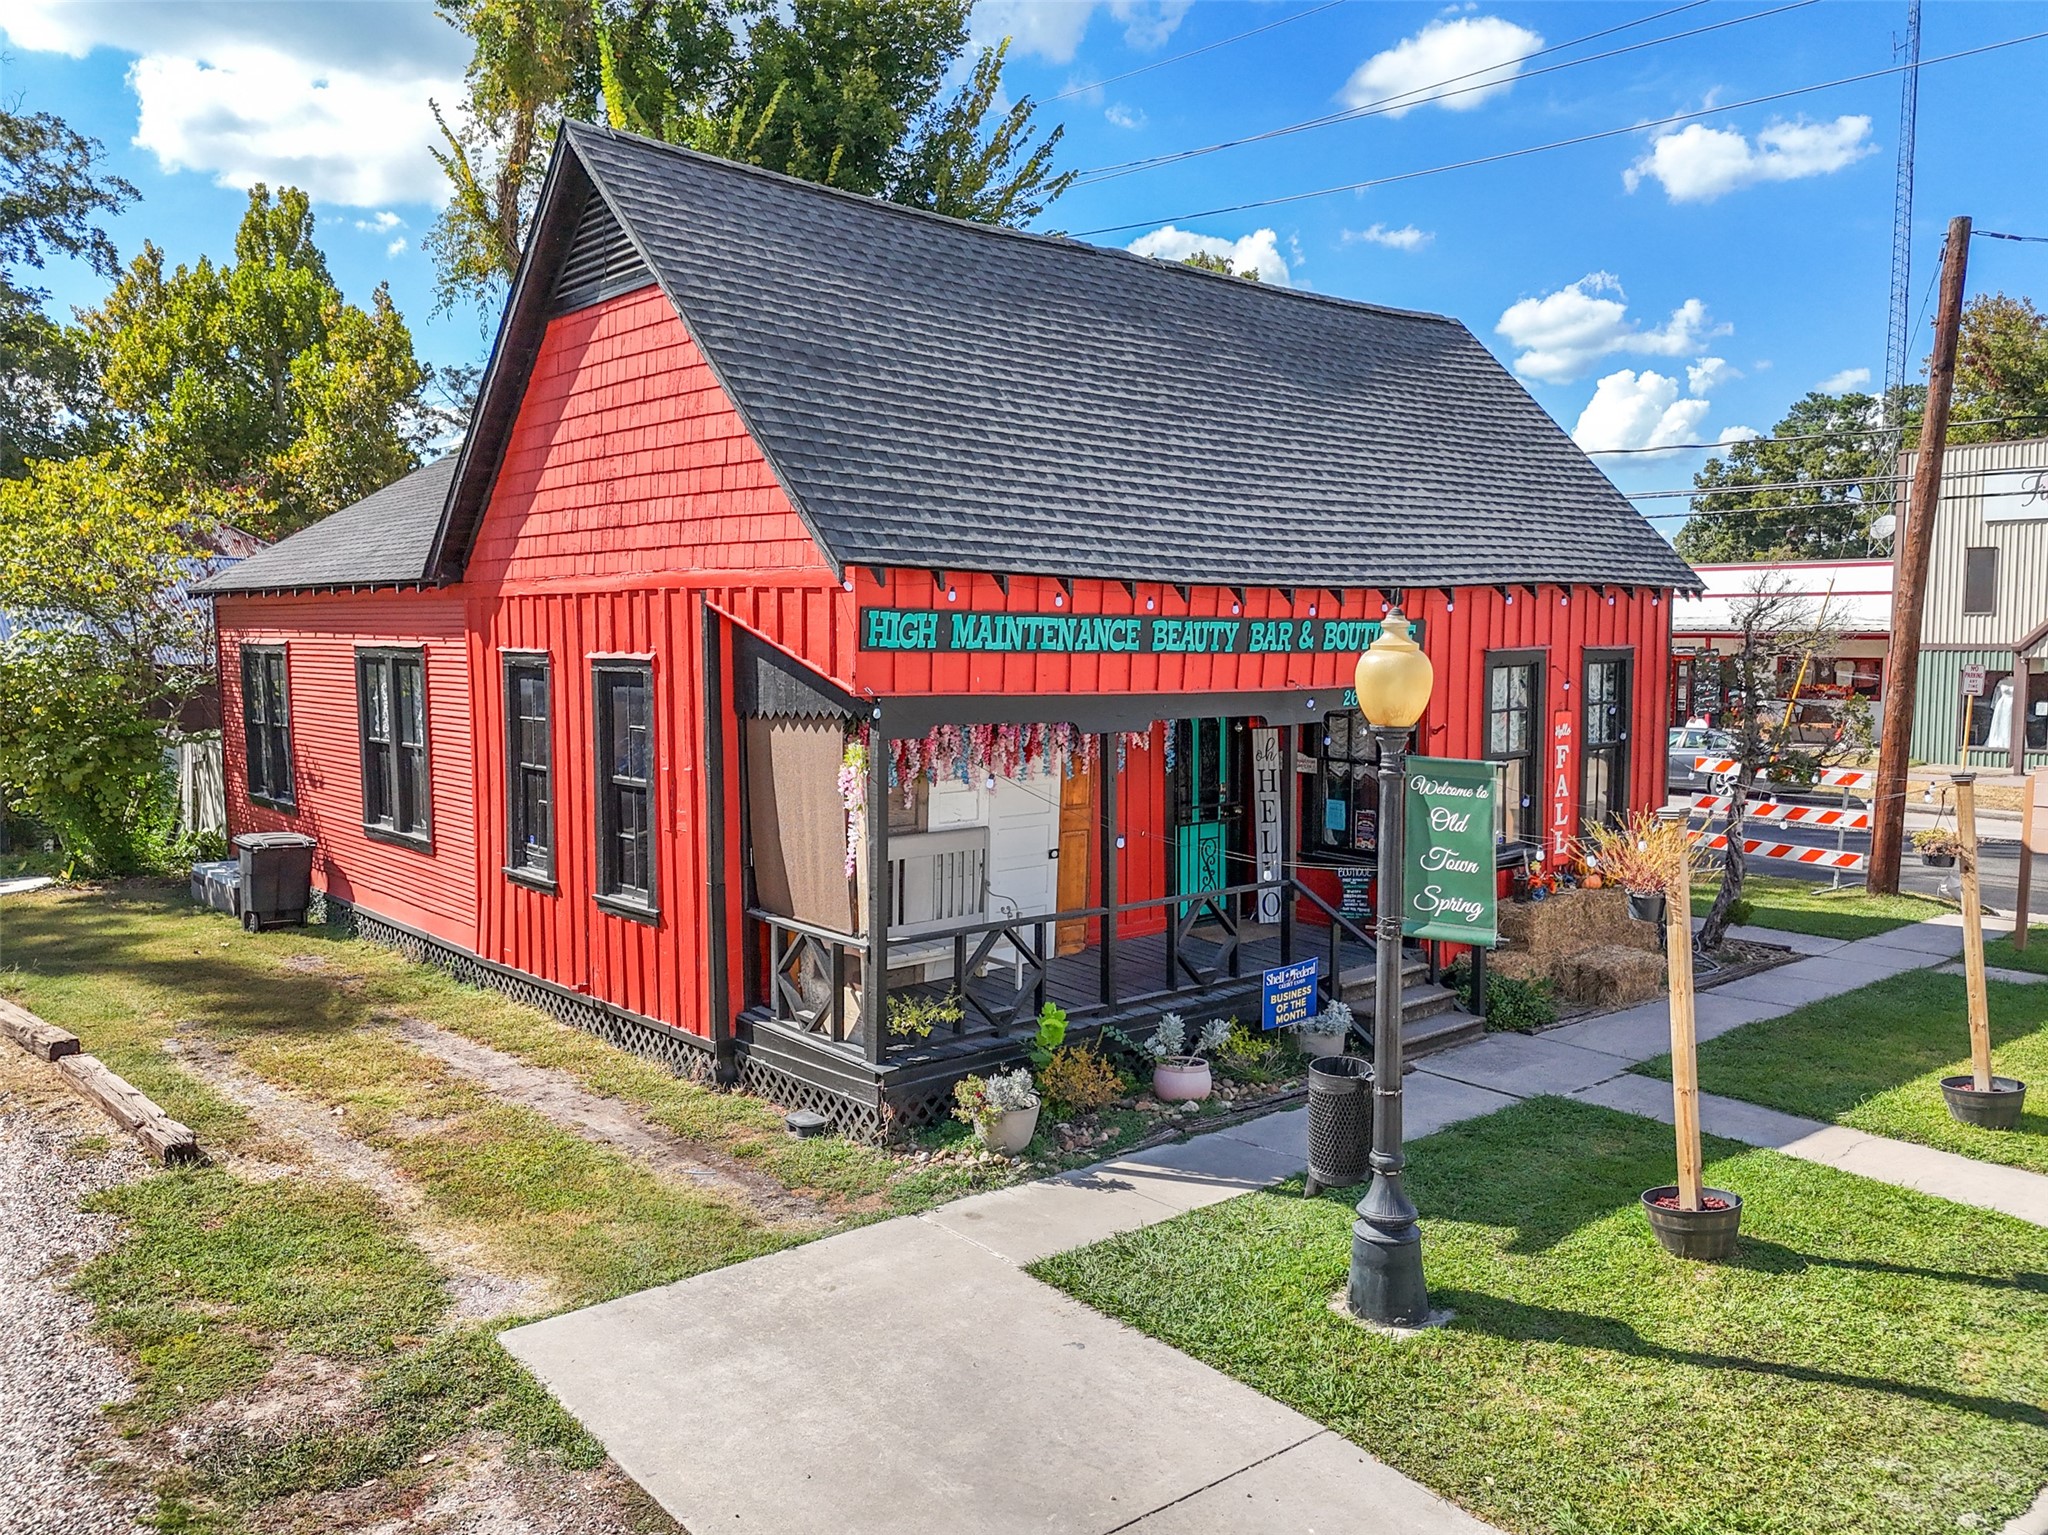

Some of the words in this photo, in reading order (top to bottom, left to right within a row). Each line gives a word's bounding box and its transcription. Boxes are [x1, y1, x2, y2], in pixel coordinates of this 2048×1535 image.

[868, 610, 938, 649] HIGH
[950, 613, 1141, 651] MAINTENANCE
[1152, 620, 1240, 652] BEAUTY
[1249, 621, 1293, 652] BAR
[1299, 620, 1314, 650] &
[1410, 775, 1474, 798] Welcome
[1475, 784, 1490, 799] to
[1554, 745, 1570, 855] FALL
[1430, 806, 1472, 833] Old
[1257, 768, 1281, 917] HELO
[1420, 846, 1480, 874] Town
[1413, 885, 1485, 922] Spring
[1266, 971, 1285, 986] Shell
[1293, 962, 1316, 980] Federal
[1270, 985, 1312, 1005] BUSINESS
[1276, 1002, 1288, 1013] OF
[1290, 997, 1307, 1009] THE
[1275, 1007, 1307, 1025] MONTH
